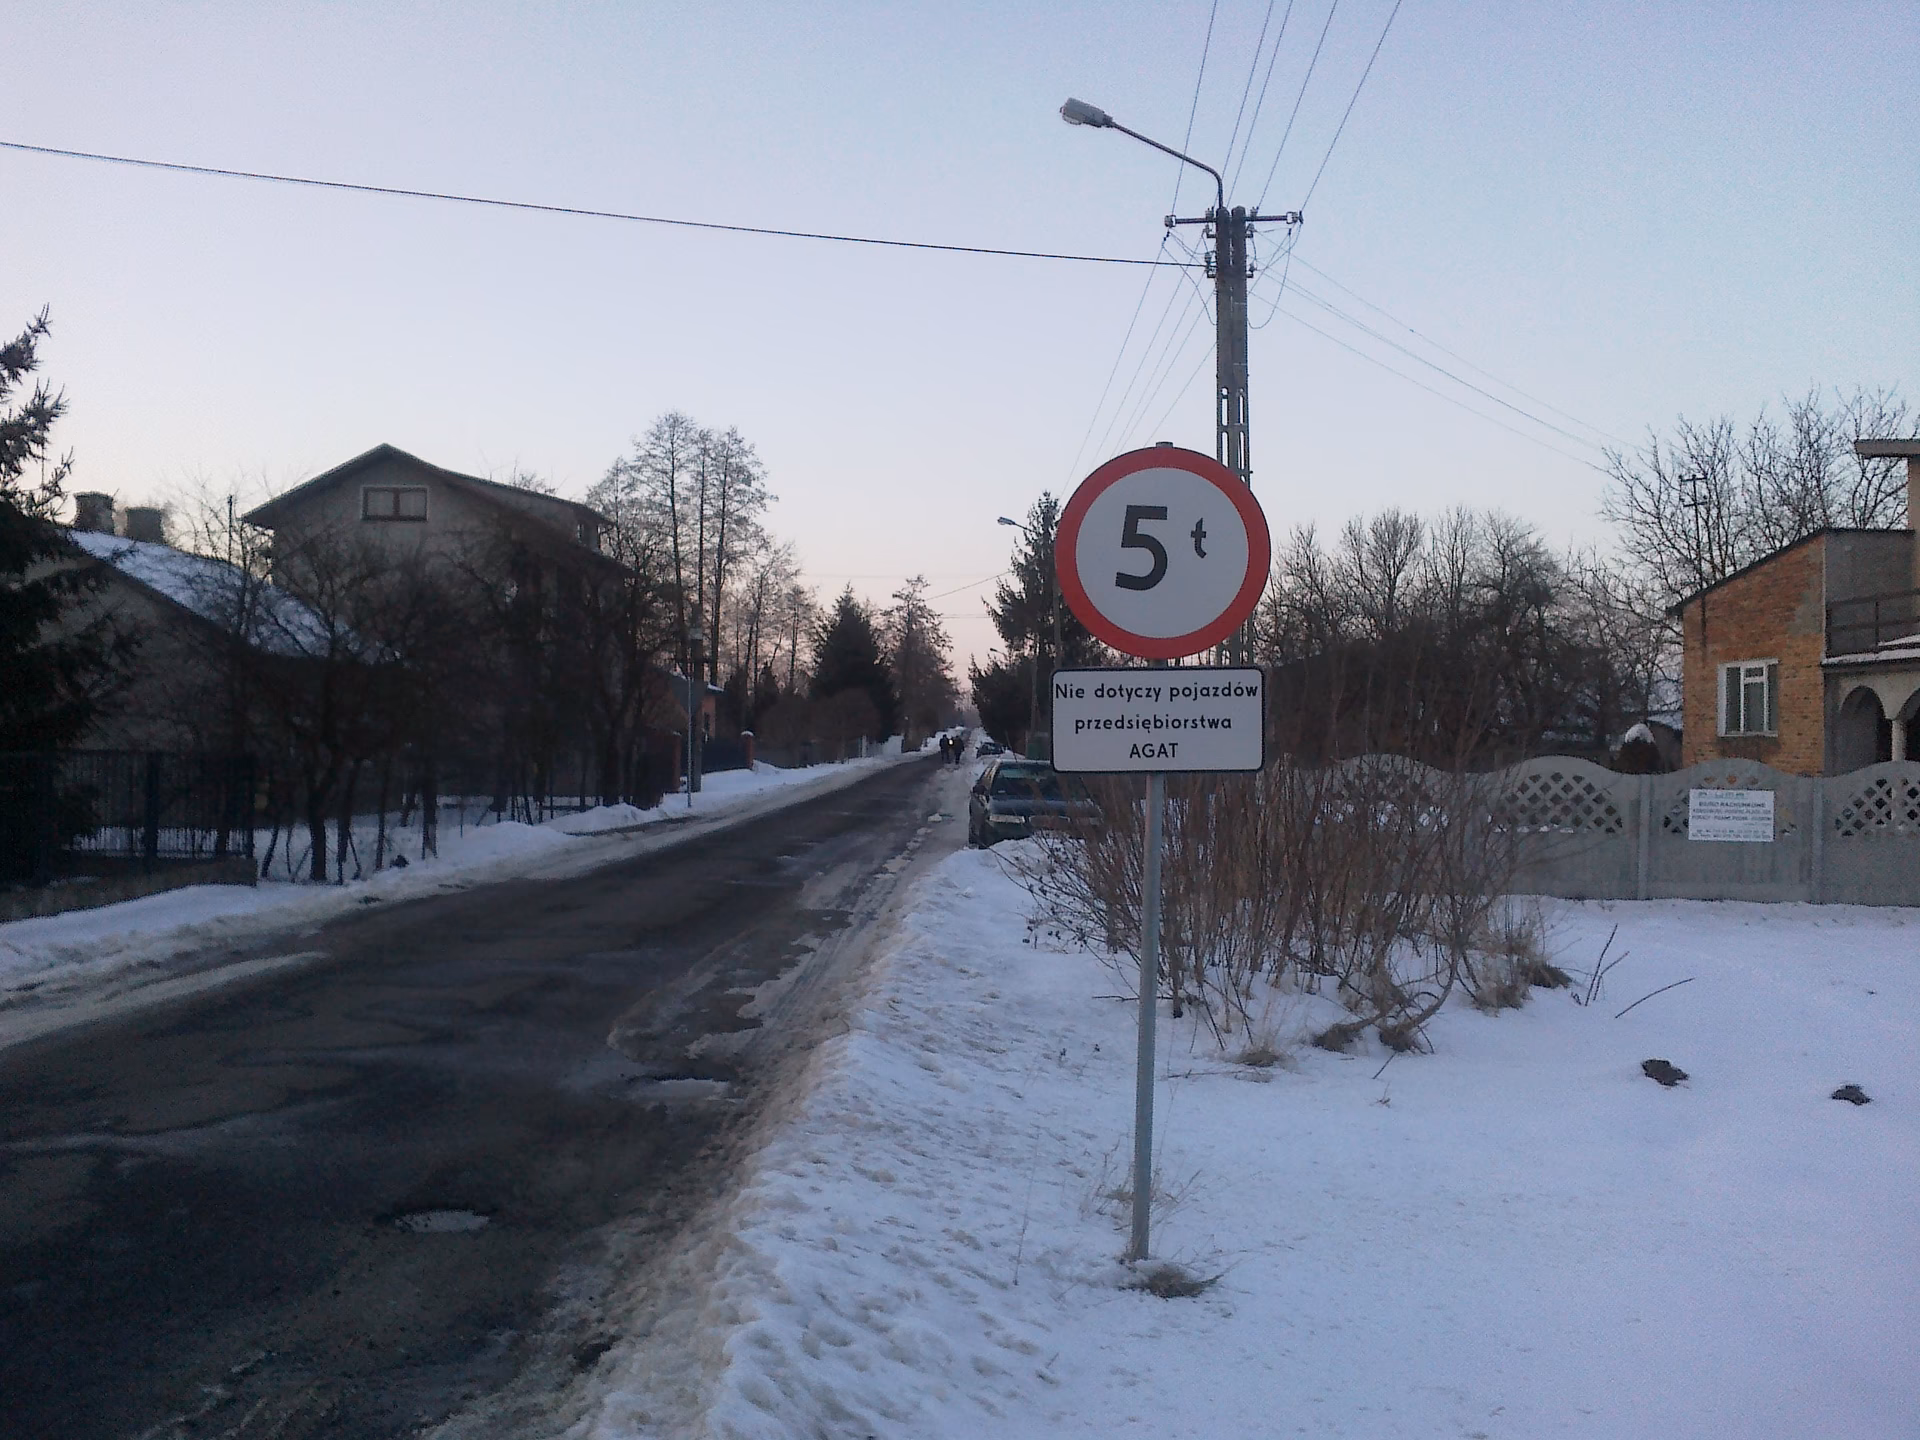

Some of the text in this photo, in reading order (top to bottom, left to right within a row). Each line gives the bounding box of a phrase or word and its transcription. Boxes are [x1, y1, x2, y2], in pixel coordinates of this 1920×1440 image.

[1115, 504, 1207, 591] 5 t
[1055, 681, 1258, 702] Nie dotyczy pojazdów
[1075, 714, 1232, 734] przedsiębiorstwa
[1129, 742, 1179, 759] AGAT
